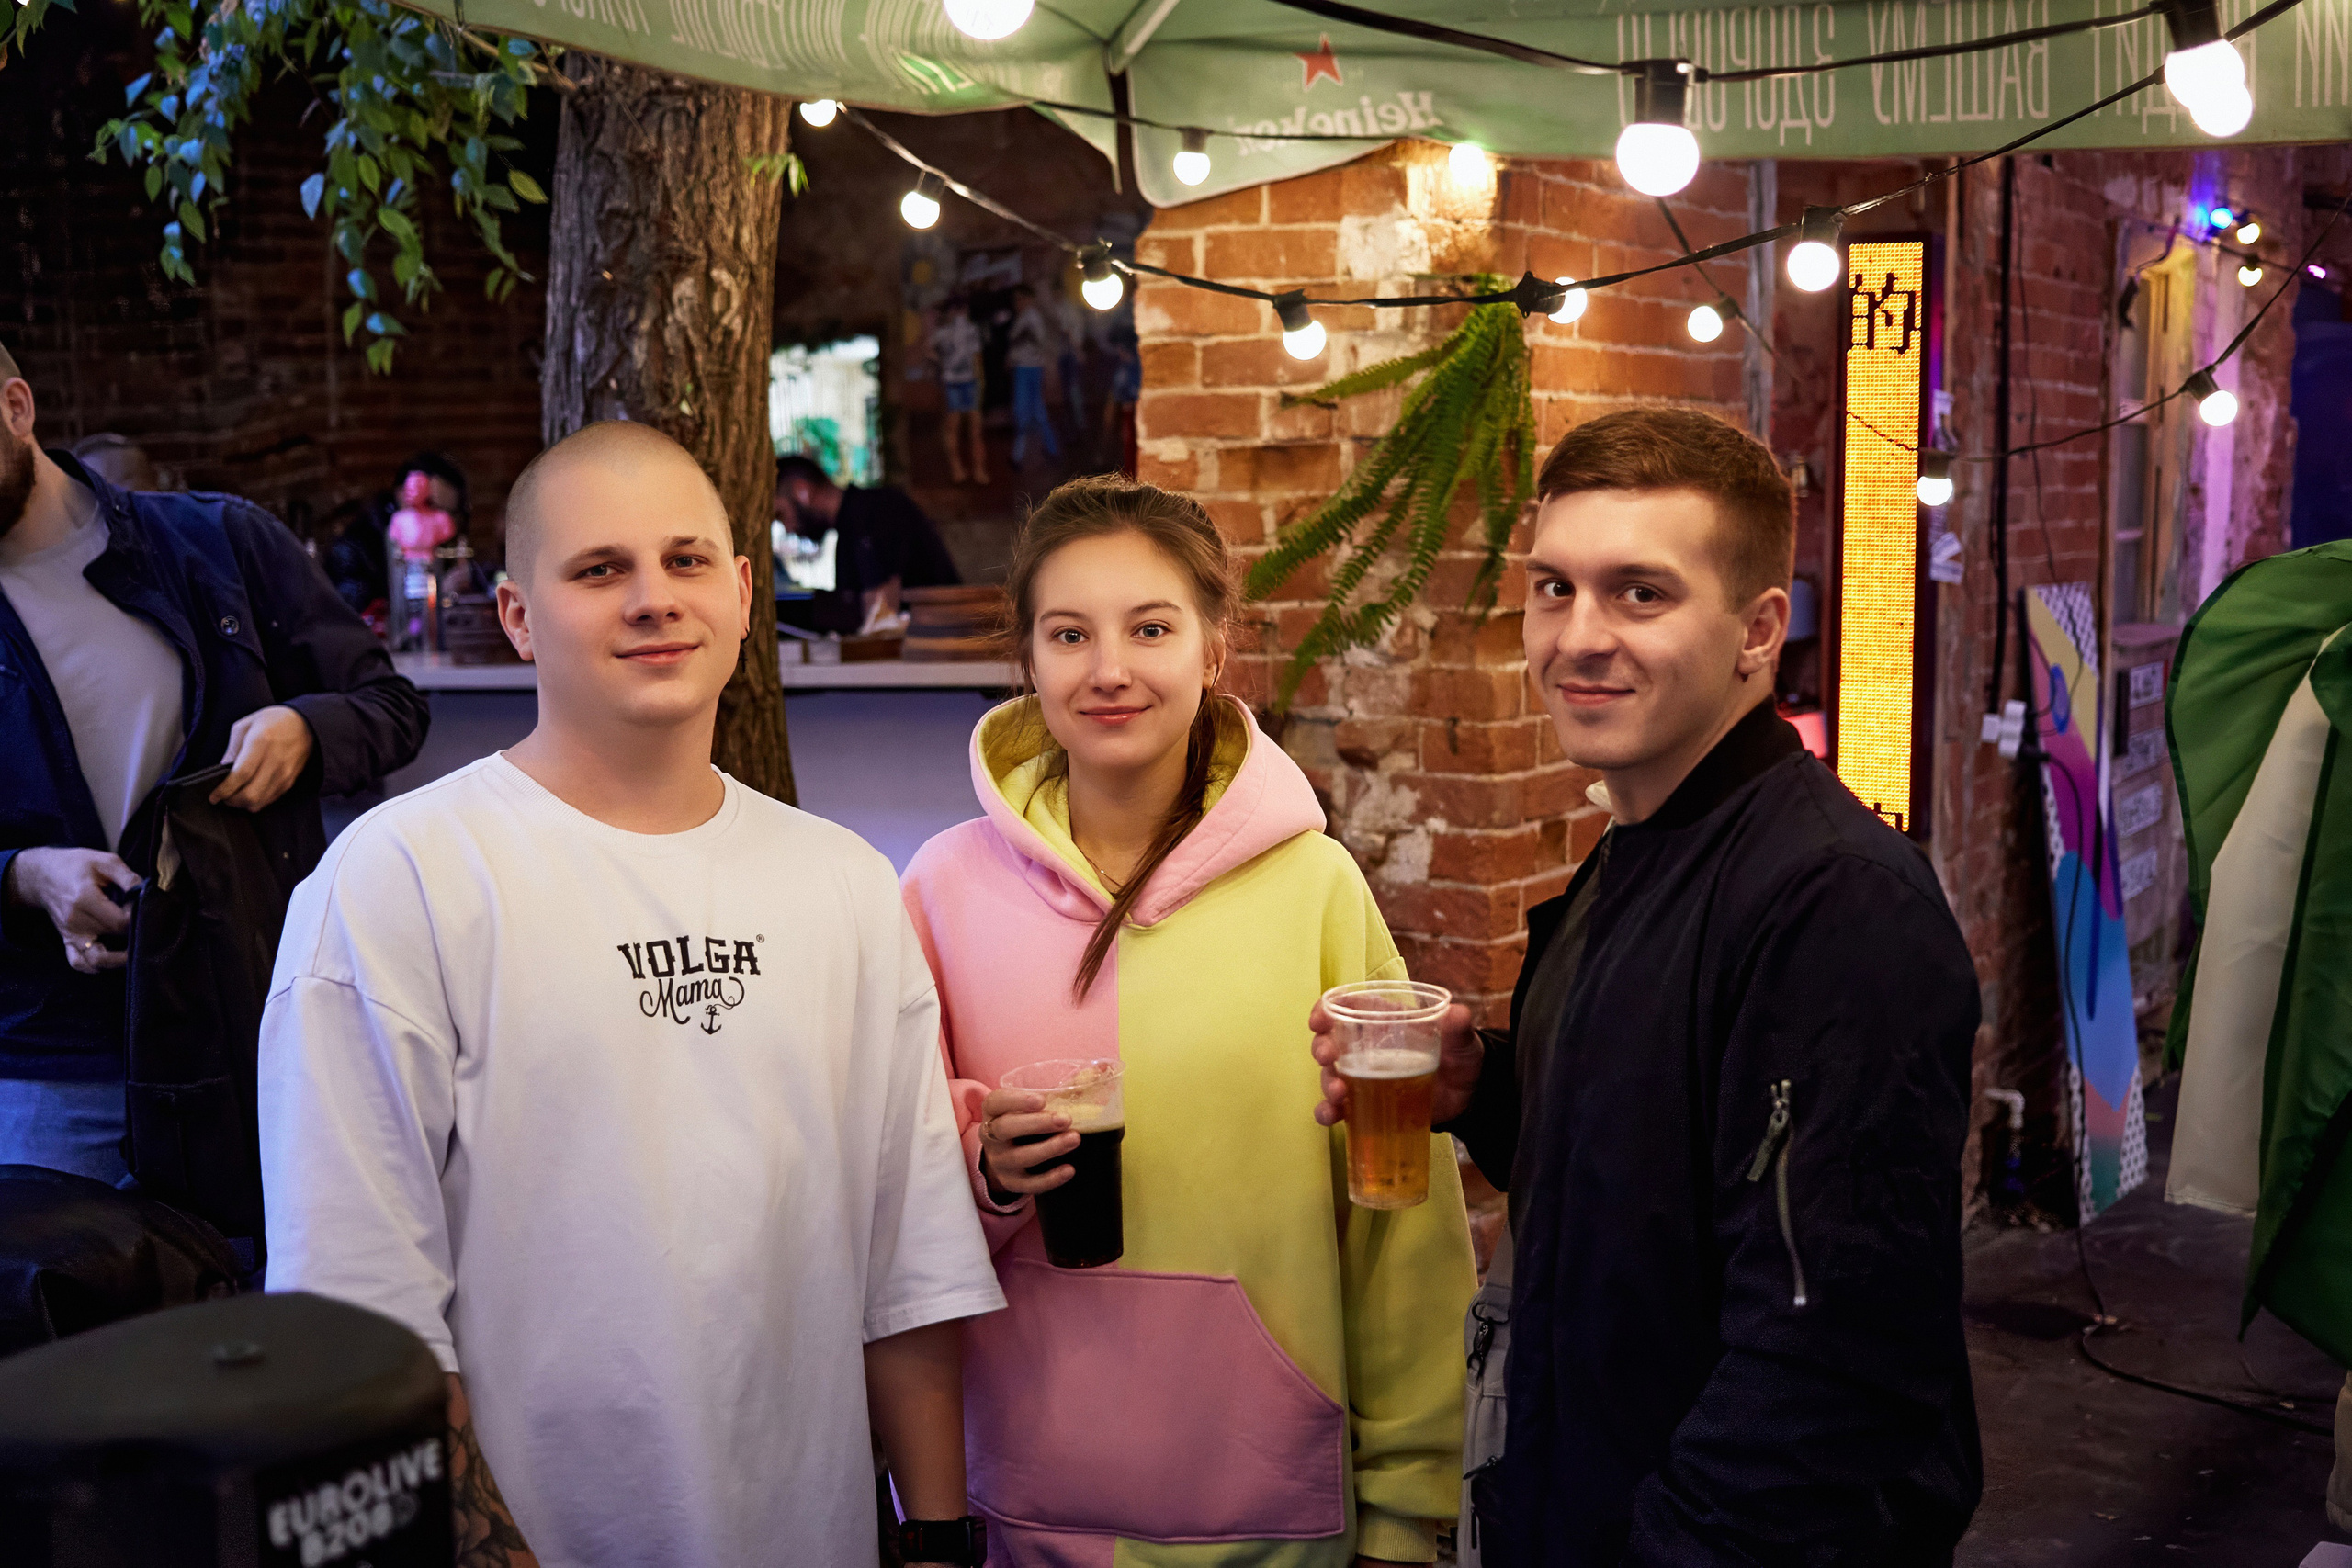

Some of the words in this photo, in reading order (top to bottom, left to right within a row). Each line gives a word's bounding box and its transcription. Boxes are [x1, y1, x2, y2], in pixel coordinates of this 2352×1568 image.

[1848, 272, 1918, 355] 的
[639, 977, 745, 1025] Mama
[267, 1438, 443, 1547] EUROLIVE
